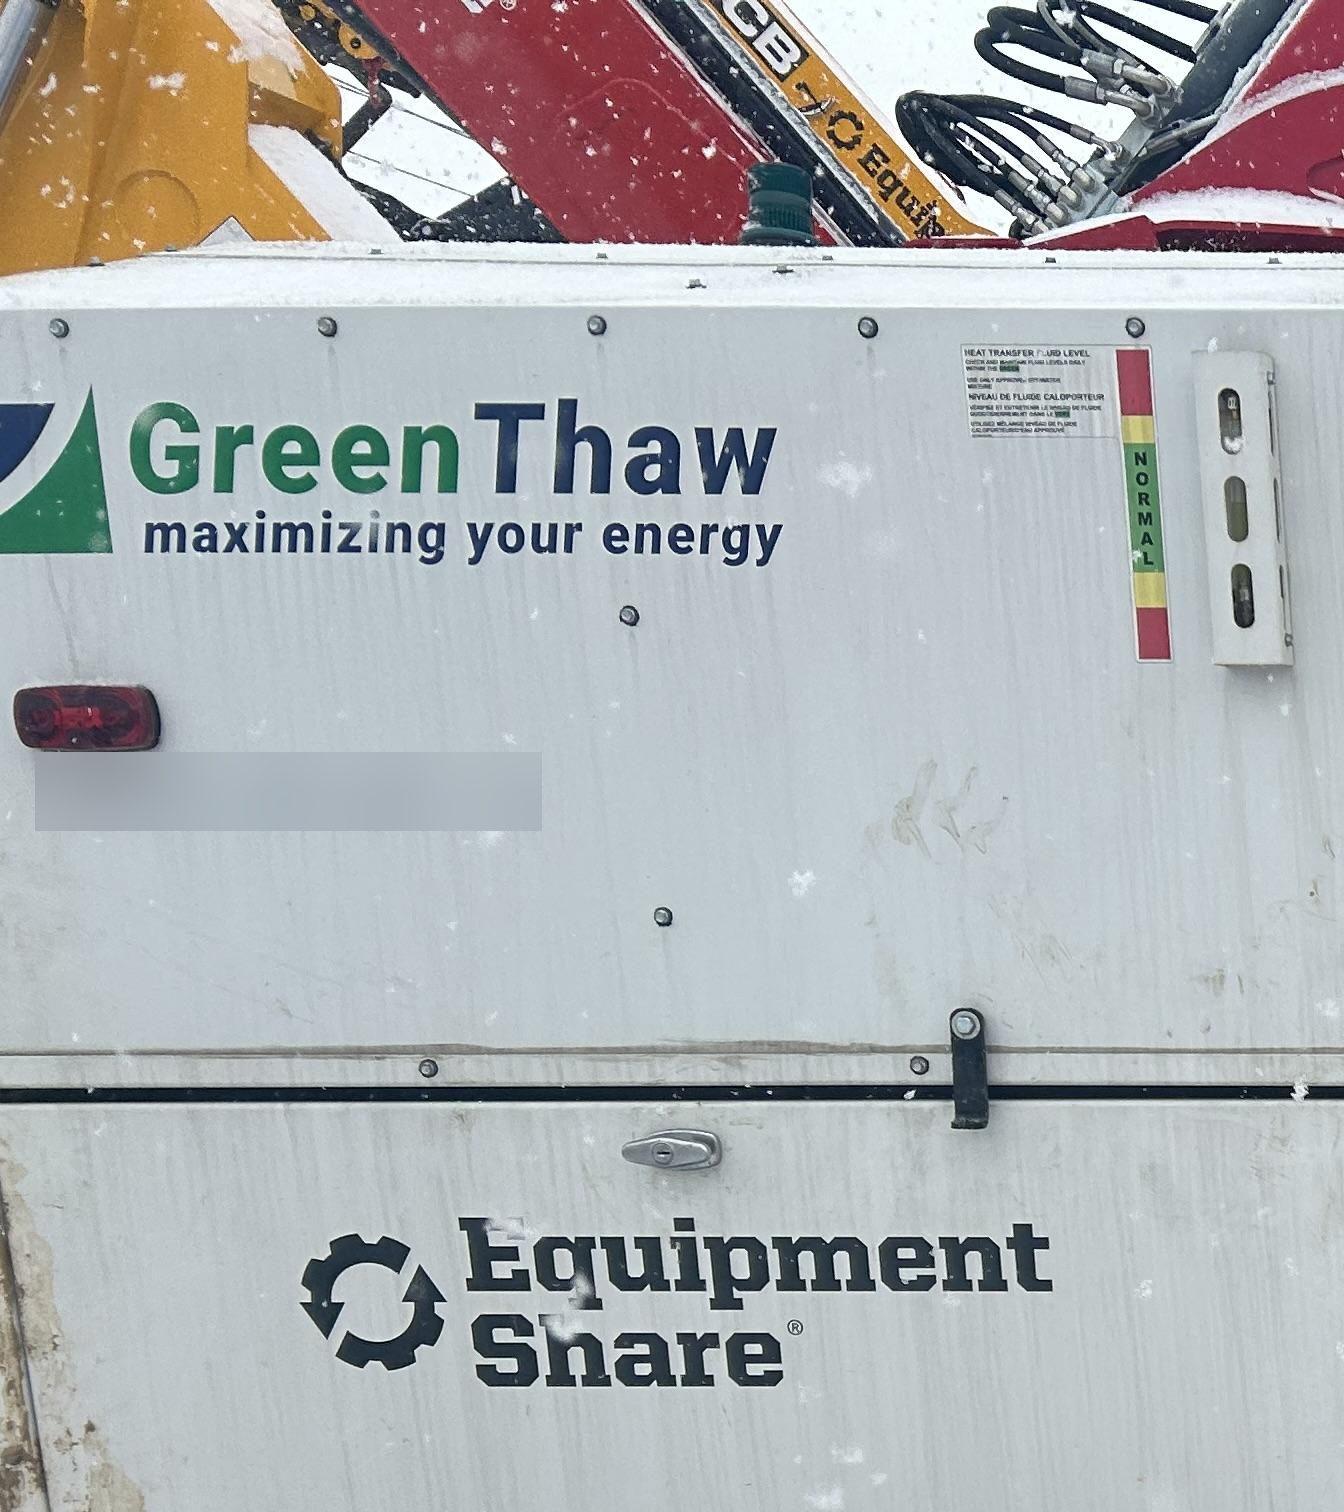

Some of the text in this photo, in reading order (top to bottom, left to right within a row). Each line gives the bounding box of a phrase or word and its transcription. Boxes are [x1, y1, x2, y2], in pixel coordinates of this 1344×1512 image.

[990, 349, 1035, 358] TRANSFER
[1035, 349, 1061, 358] UID
[129, 397, 779, 496] GreenThaw
[144, 509, 784, 567] maximizing your energy
[1133, 452, 1155, 566] NORMAL
[458, 1216, 1053, 1310] Equipment
[473, 1313, 784, 1388] Share
